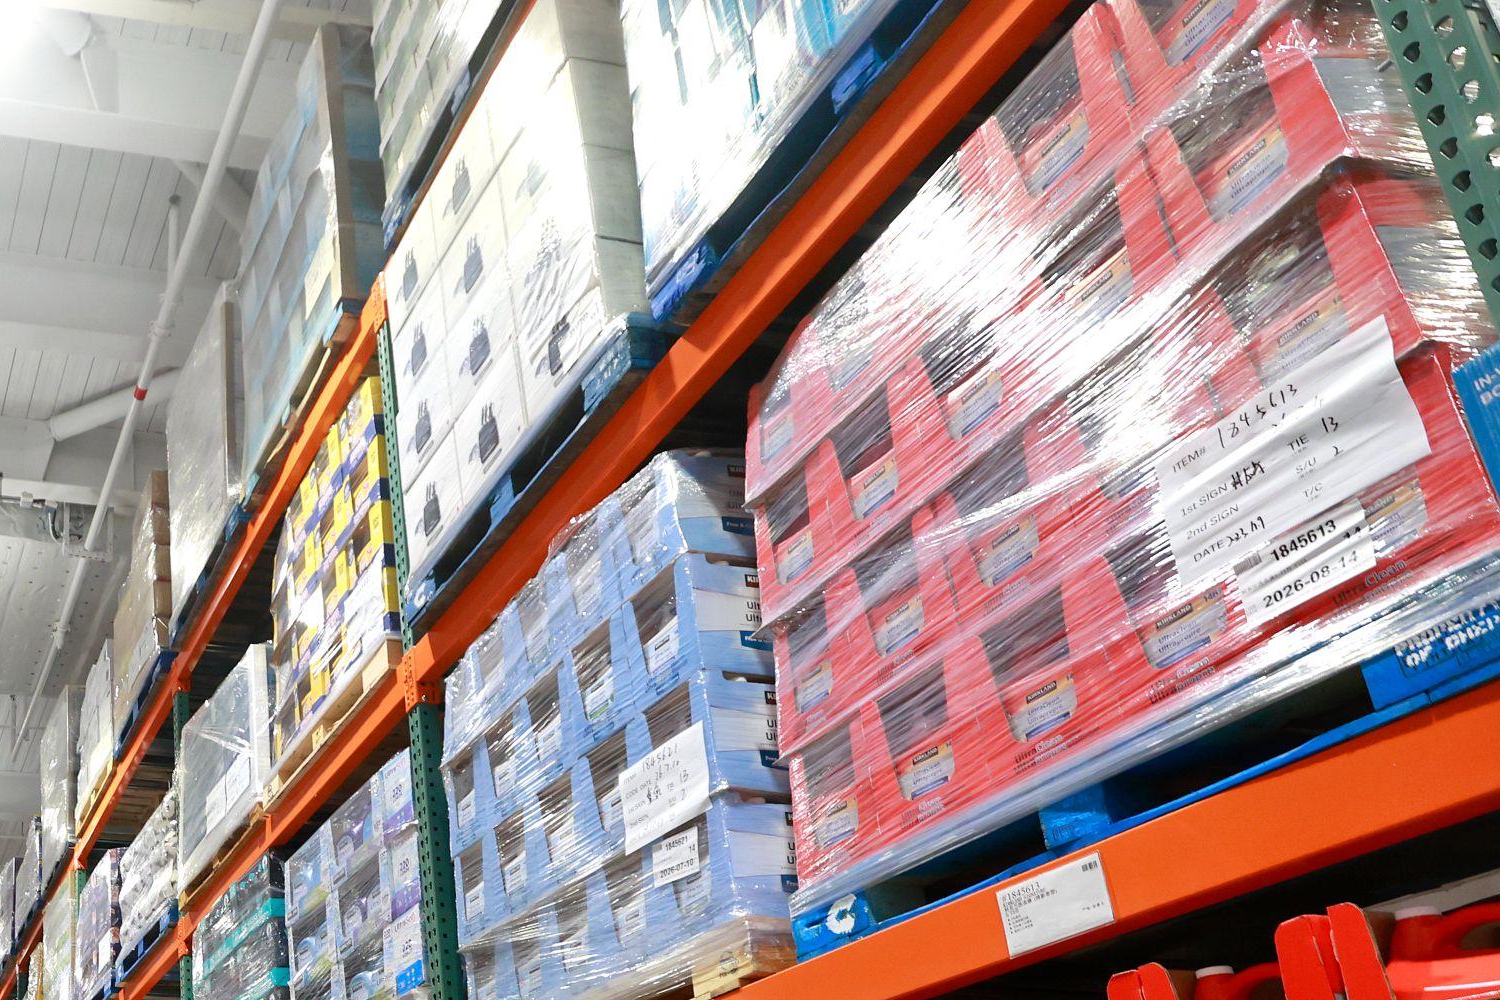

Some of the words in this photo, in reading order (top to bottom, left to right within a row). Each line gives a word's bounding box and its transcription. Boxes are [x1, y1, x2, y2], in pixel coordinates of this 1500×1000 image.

[1286, 433, 1309, 452] TIE
[1172, 445, 1206, 474] ITEM#
[1199, 482, 1229, 509] SIGN
[1208, 504, 1240, 528] SIGN
[1193, 540, 1226, 564] DATE
[1269, 519, 1337, 562] 1845613
[1262, 549, 1359, 610] 2026-08-14
[665, 834, 688, 852] 1845621
[660, 857, 694, 879] 2026-07-10
